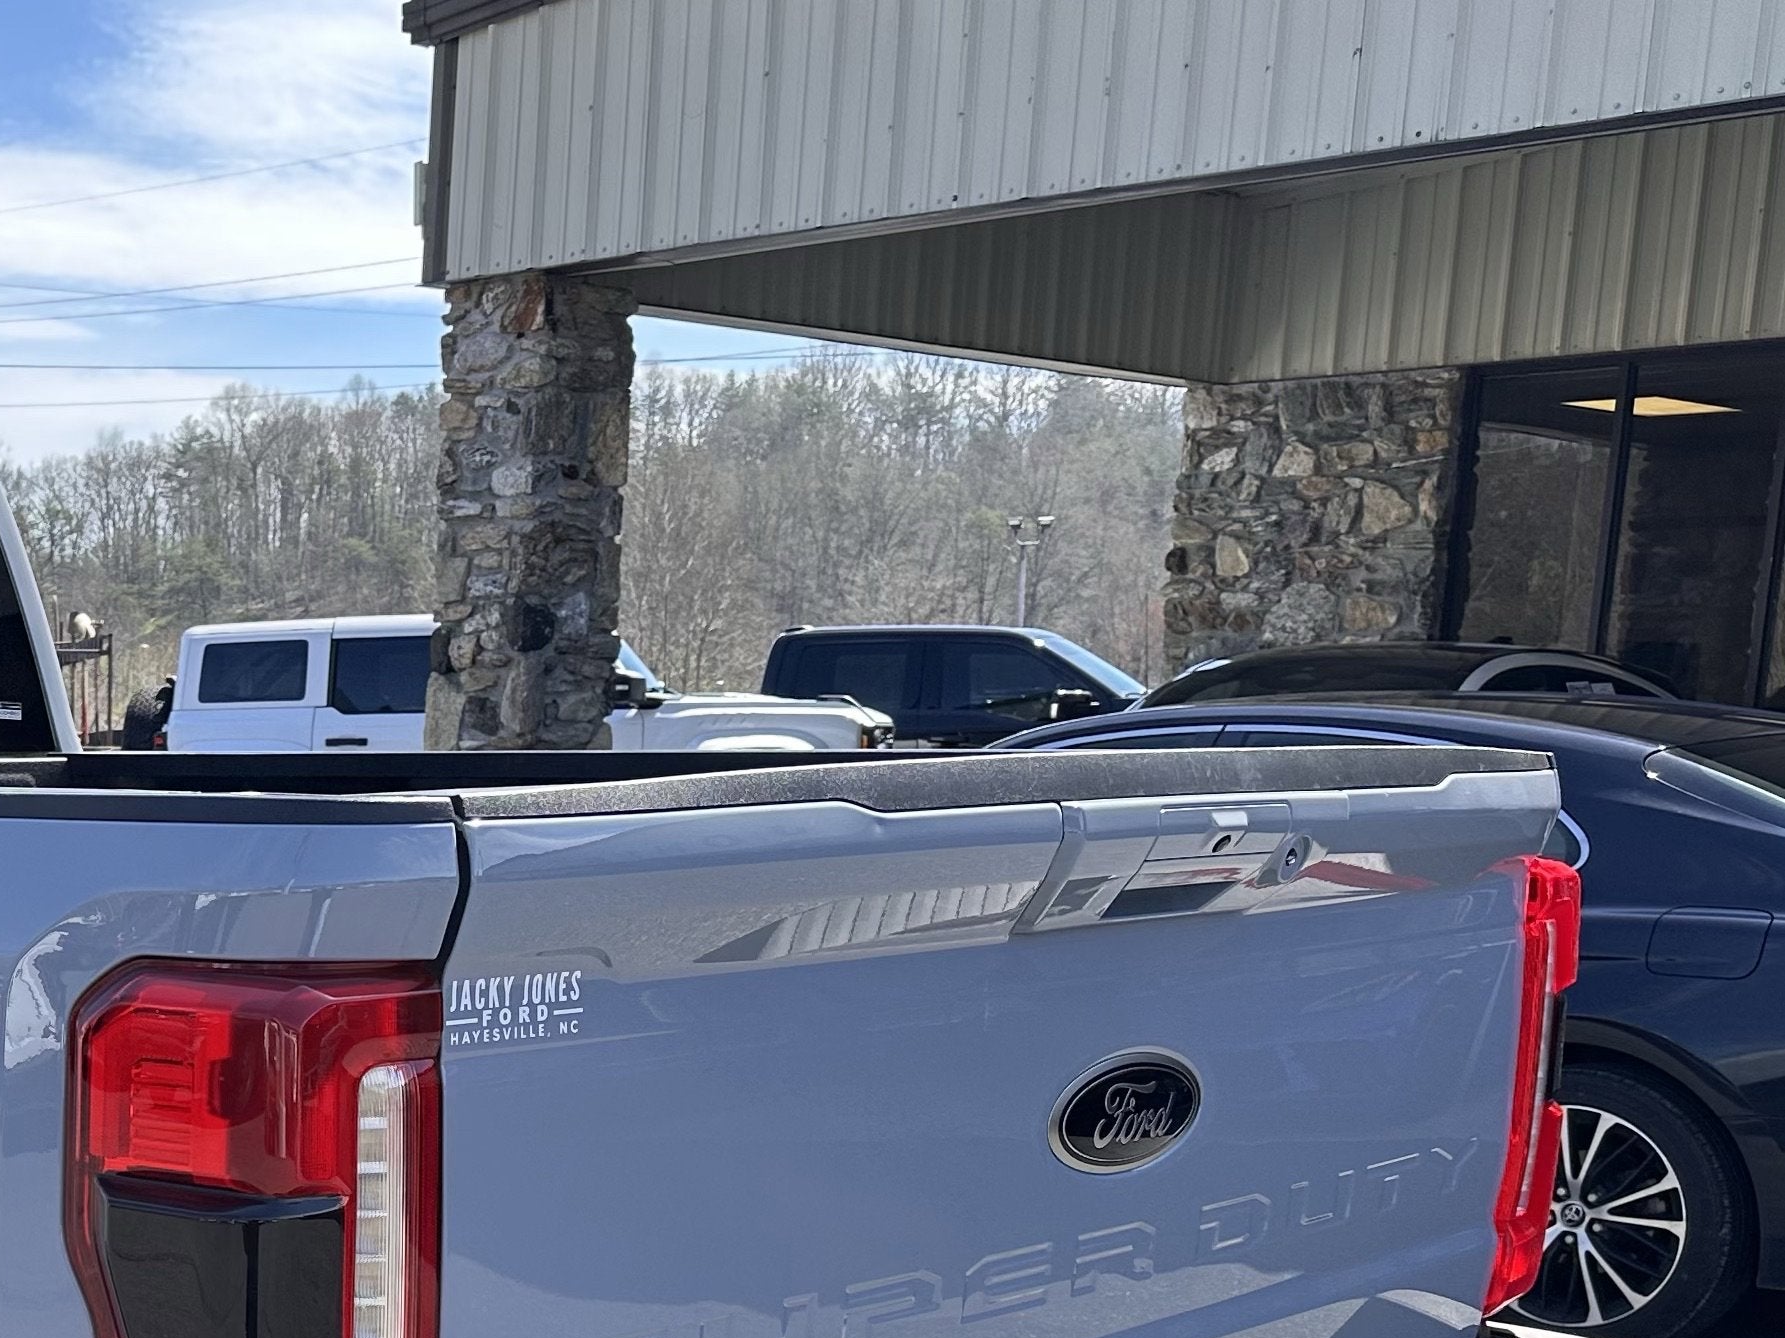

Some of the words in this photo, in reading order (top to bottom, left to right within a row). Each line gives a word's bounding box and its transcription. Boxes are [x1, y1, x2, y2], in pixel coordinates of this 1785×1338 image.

[450, 975, 515, 1013] JACKY
[522, 970, 582, 1006] JONES
[450, 1023, 551, 1046] HAYESVILLE,
[559, 1020, 580, 1035] NC
[482, 1004, 549, 1027] FORD
[1093, 1080, 1174, 1149] Ford
[1198, 1136, 1481, 1260] DUTY
